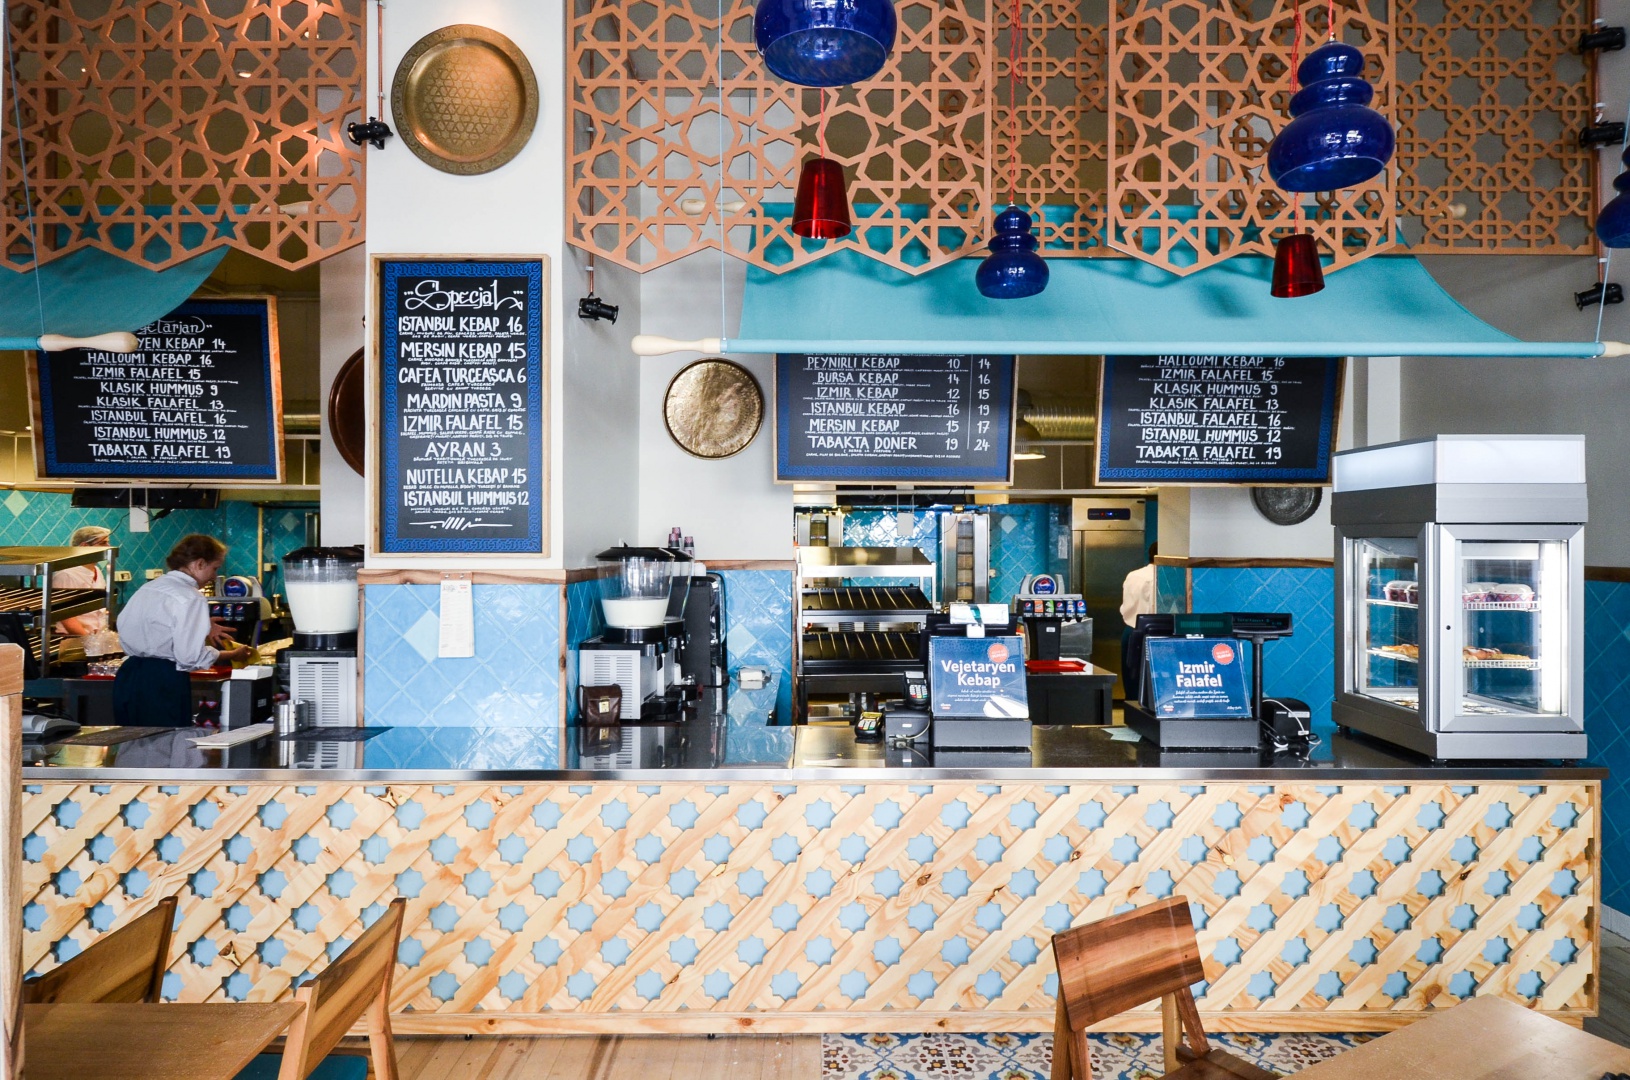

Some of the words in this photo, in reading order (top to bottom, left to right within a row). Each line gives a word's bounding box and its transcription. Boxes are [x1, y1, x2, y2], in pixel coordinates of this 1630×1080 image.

[398, 316, 456, 332] ISTANBUL
[460, 316, 500, 332] KEBAP
[507, 316, 523, 332] 16
[165, 337, 205, 350] KEBAP
[212, 338, 226, 350] 14
[400, 342, 455, 358] MERSIN
[459, 342, 501, 359] KEBAP
[507, 342, 527, 359] 15
[88, 352, 146, 365] HALLOUMI
[152, 353, 192, 365] KEBAP
[199, 354, 212, 366] 16
[807, 356, 857, 368] PEYNIRLI
[862, 357, 900, 369] KEBAP
[947, 358, 960, 369] 10
[978, 359, 991, 370] 14
[1158, 355, 1218, 367] HALLOUMI
[1222, 356, 1264, 367] KEBAP
[1273, 357, 1285, 367] 16
[92, 366, 126, 378] IZMIR
[130, 367, 184, 379] FALAFEL
[188, 368, 201, 379] 15
[398, 367, 442, 384] CAFEA
[517, 367, 527, 384] 6
[817, 372, 854, 383] BURSA
[859, 373, 899, 384] KEBAP
[947, 374, 960, 385] 14
[978, 374, 990, 385] 16
[1161, 368, 1196, 380] IZMIR
[1201, 369, 1254, 381] FALAFEL
[1261, 370, 1274, 381] 15
[101, 382, 145, 394] KLASIK
[150, 383, 204, 396] HUMMUS
[210, 384, 218, 396] 9
[817, 387, 852, 398] IZMIR
[857, 387, 899, 399] KEBAP
[946, 388, 960, 399] 12
[977, 389, 990, 400] 15
[1153, 382, 1202, 395] KLASIK
[1207, 383, 1261, 395] HUMMUS
[1270, 384, 1278, 396] 9
[96, 396, 141, 407] KLASIK
[147, 397, 200, 409] FALAFEL
[209, 400, 224, 410] 13
[407, 393, 462, 409] MARDIN
[464, 393, 506, 408] PASTA
[510, 393, 522, 408] 9
[1149, 397, 1198, 409] KLASIK
[1203, 398, 1256, 410] FALAFEL
[1265, 398, 1279, 410] 13
[811, 402, 865, 414] ISTANBUL
[868, 403, 905, 415] KEBAP
[946, 404, 960, 415] 16
[978, 404, 990, 416] 19
[91, 410, 147, 422] ISTANBUL
[152, 411, 206, 424] FALAFEL
[213, 413, 227, 424] 16
[403, 414, 443, 432] IZMIR
[446, 414, 502, 430] FALAFEL
[506, 414, 523, 430] 15
[1140, 411, 1198, 425] ISTANBUL
[1202, 412, 1258, 426] FALAFEL
[1267, 414, 1281, 426] 16
[94, 426, 151, 439] ISTANBUL
[154, 427, 207, 440] HUMMUS
[212, 429, 226, 440] 12
[809, 418, 856, 432] MERSIN
[861, 419, 900, 432] KEBAP
[946, 420, 959, 433] 15
[977, 420, 990, 434] 17
[1142, 427, 1201, 441] ISTANBUL
[1205, 429, 1258, 442] HUMMUS
[1266, 429, 1281, 443] 12
[424, 441, 485, 458] AYRAN
[490, 442, 502, 457] 3
[807, 435, 869, 449] TABAKTA
[874, 436, 917, 450] DONER
[945, 438, 958, 450] 19
[974, 439, 990, 451] 24
[88, 443, 148, 457] TABAKTA
[153, 445, 210, 459] FALAFEL
[215, 446, 231, 459] 19
[1136, 445, 1198, 459] TABAKTA
[1203, 446, 1256, 459] FALAFEL
[1265, 447, 1282, 460] 19
[406, 468, 465, 485] NUTELLA
[468, 468, 508, 484] KEBAP
[511, 468, 527, 484] 15
[404, 490, 464, 506] ISTANBUL
[467, 491, 517, 506] HUMMUS
[517, 491, 529, 506] 12
[941, 659, 1015, 676] Vejetaryen
[1179, 660, 1215, 674] Izmir
[957, 674, 1001, 688] Kebap
[1176, 674, 1223, 687] Falafel
